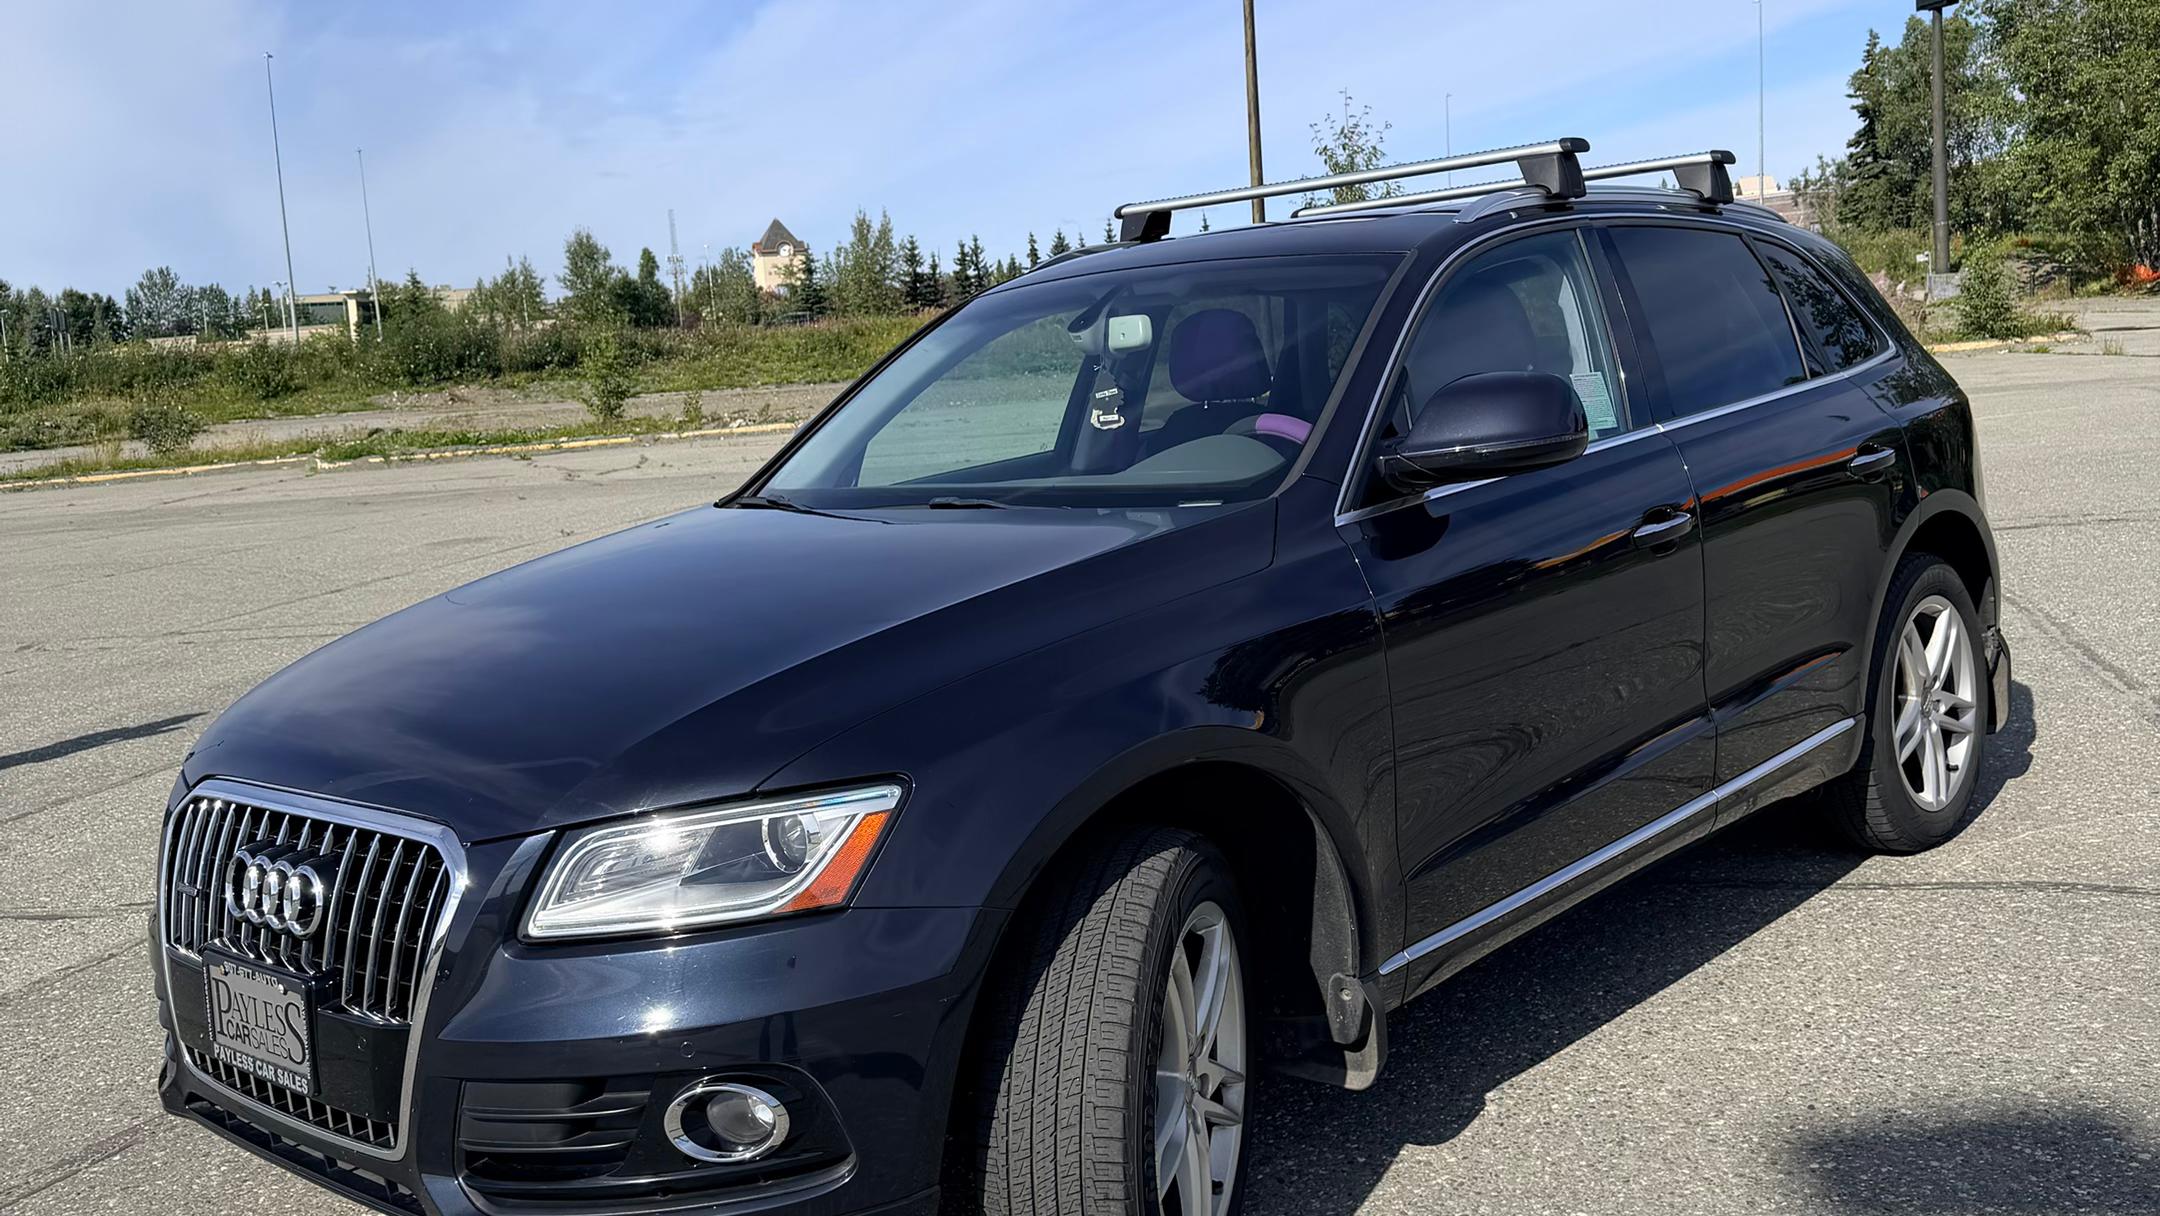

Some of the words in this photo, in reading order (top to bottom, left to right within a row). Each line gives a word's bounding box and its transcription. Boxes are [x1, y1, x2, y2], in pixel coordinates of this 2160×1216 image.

[212, 977, 306, 1065] PAYLESS
[213, 1043, 254, 1073] PAYLESS
[255, 1060, 276, 1082] CAR
[277, 1068, 309, 1094] SALES
